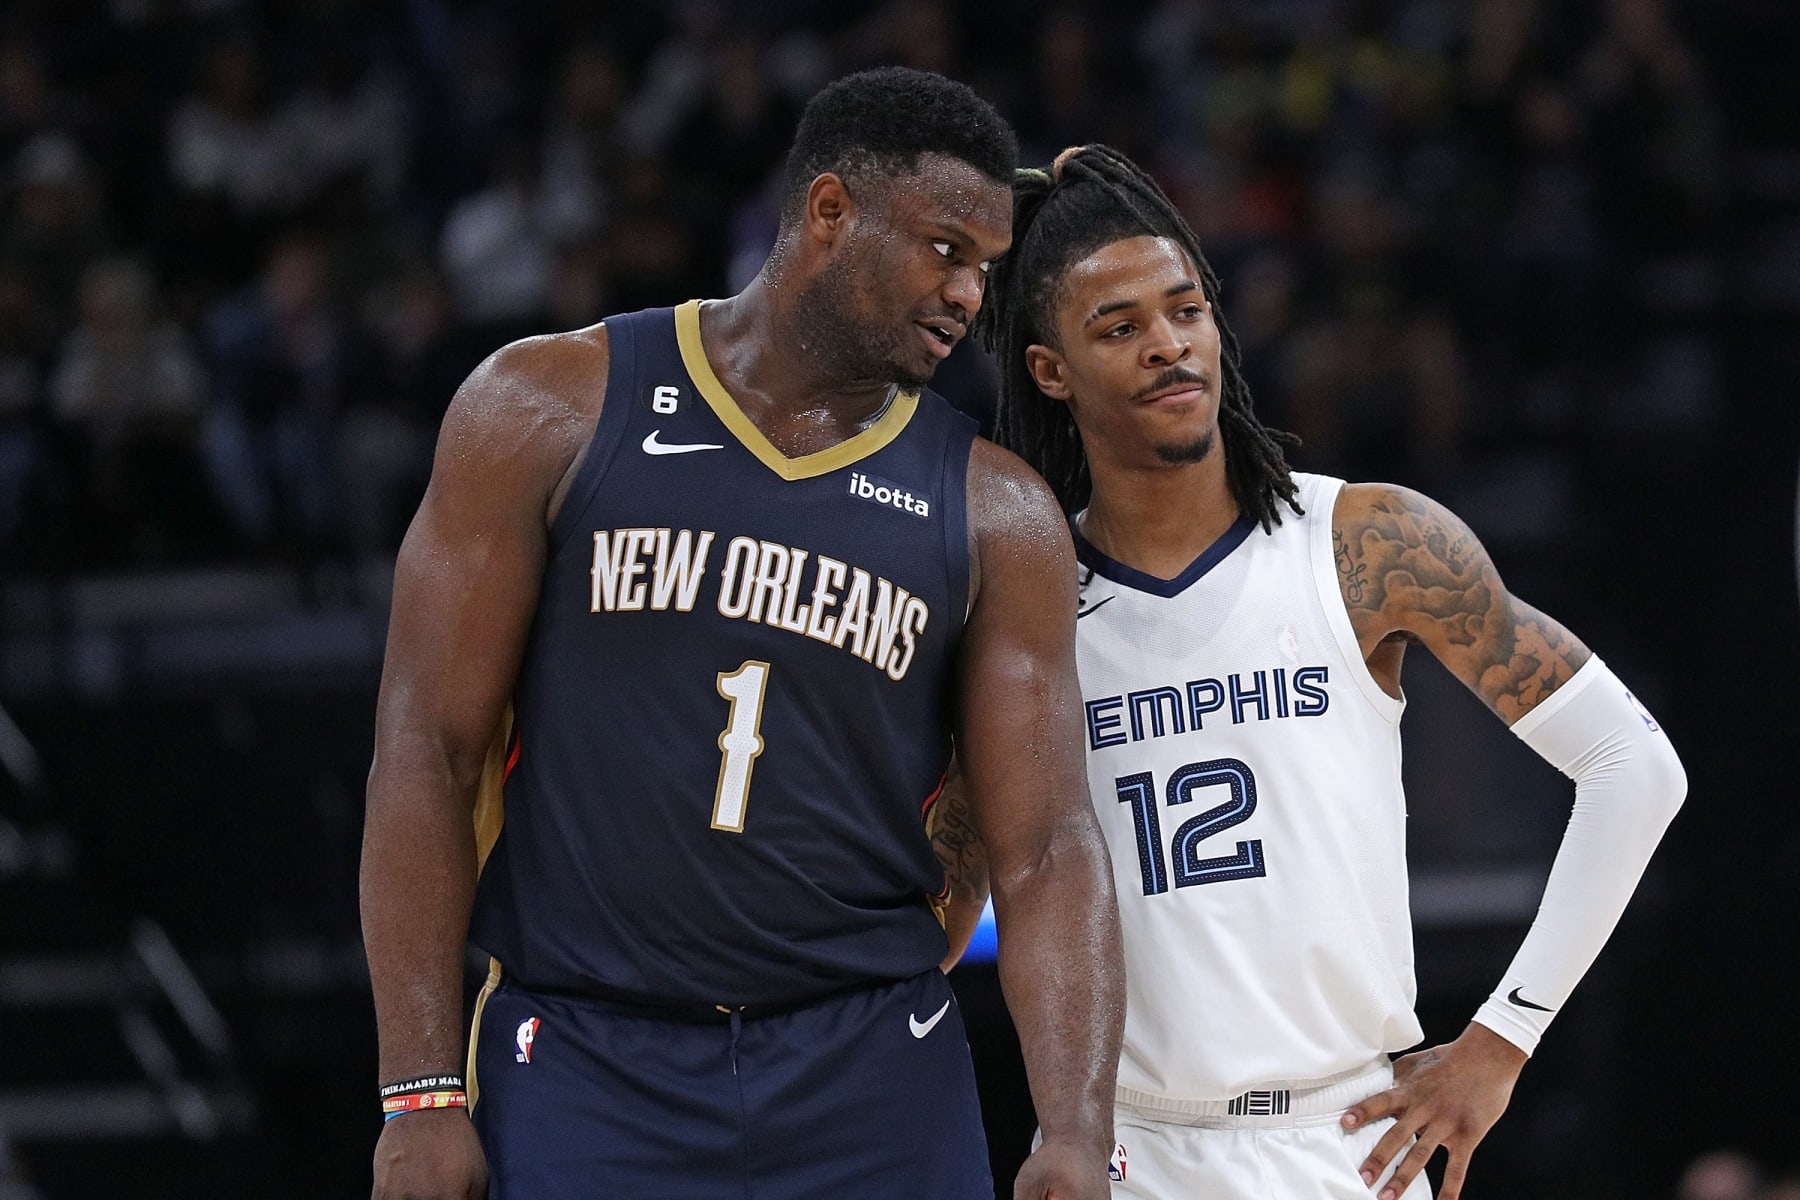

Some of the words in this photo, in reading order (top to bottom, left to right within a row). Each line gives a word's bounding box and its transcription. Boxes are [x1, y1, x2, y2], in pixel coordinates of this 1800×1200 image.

[652, 386, 680, 415] 6
[848, 472, 930, 518] ibotta
[590, 528, 716, 613] NEW
[717, 536, 929, 681] ORLEANS
[710, 659, 770, 833] 1
[1085, 666, 1329, 751] EMPHIS
[1115, 757, 1267, 897] 12
